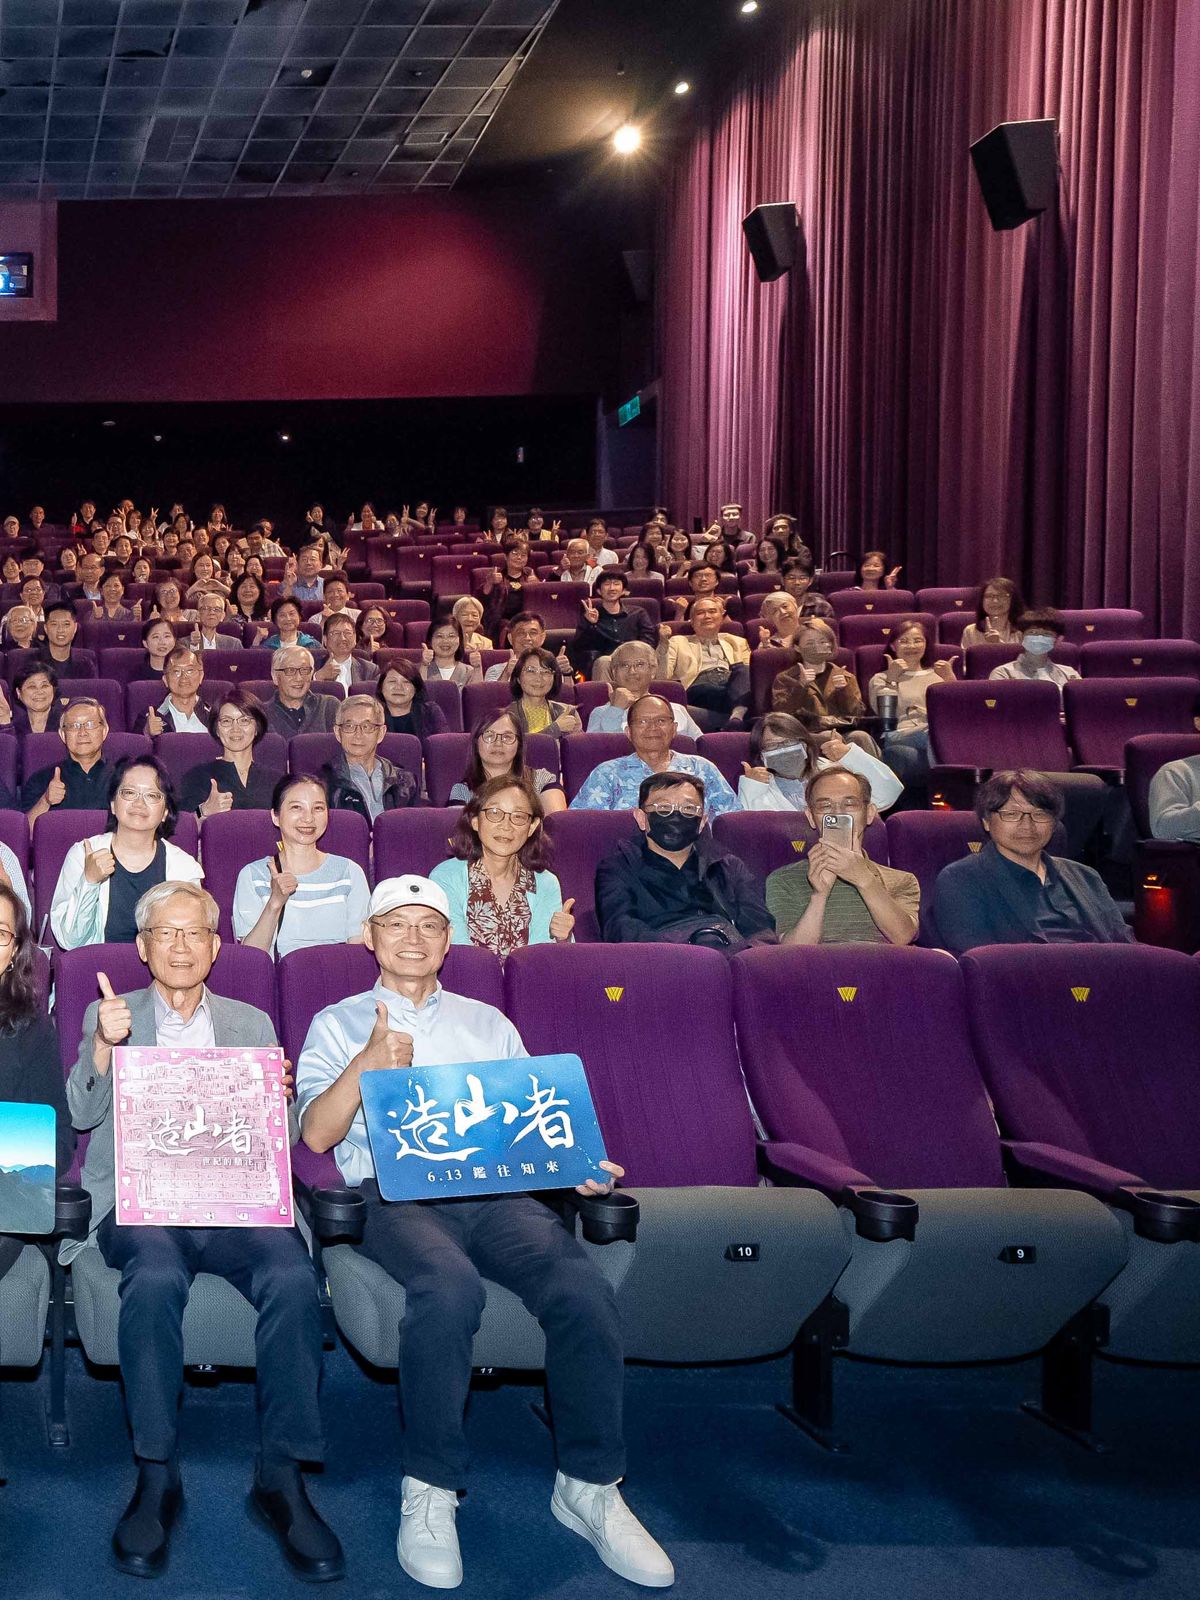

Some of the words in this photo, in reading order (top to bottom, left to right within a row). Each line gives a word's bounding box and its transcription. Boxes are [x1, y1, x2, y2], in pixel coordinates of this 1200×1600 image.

[387, 1074, 575, 1161] 造山者
[146, 1104, 253, 1155] 造山者
[427, 1168, 463, 1183] 6.13
[737, 1246, 753, 1257] 10
[1016, 1248, 1025, 1259] 9
